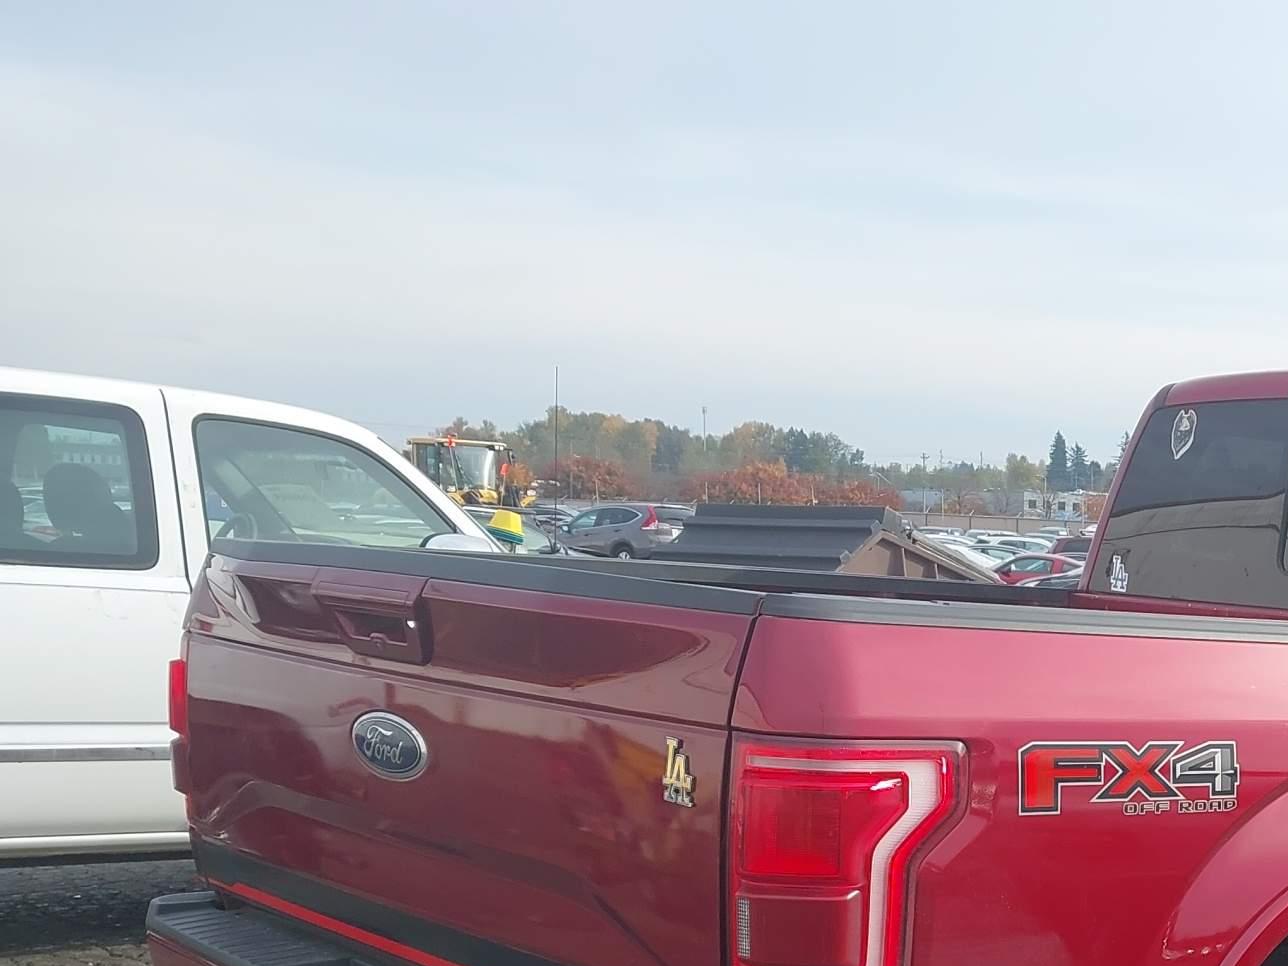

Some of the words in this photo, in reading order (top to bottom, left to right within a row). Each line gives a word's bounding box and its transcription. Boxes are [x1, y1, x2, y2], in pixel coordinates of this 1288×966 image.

[1110, 554, 1128, 592] LA
[363, 724, 404, 764] Ford
[662, 735, 693, 808] LA
[1018, 741, 1240, 816] FX4
[1123, 800, 1170, 816] OFF
[1178, 798, 1238, 814] ROAD
